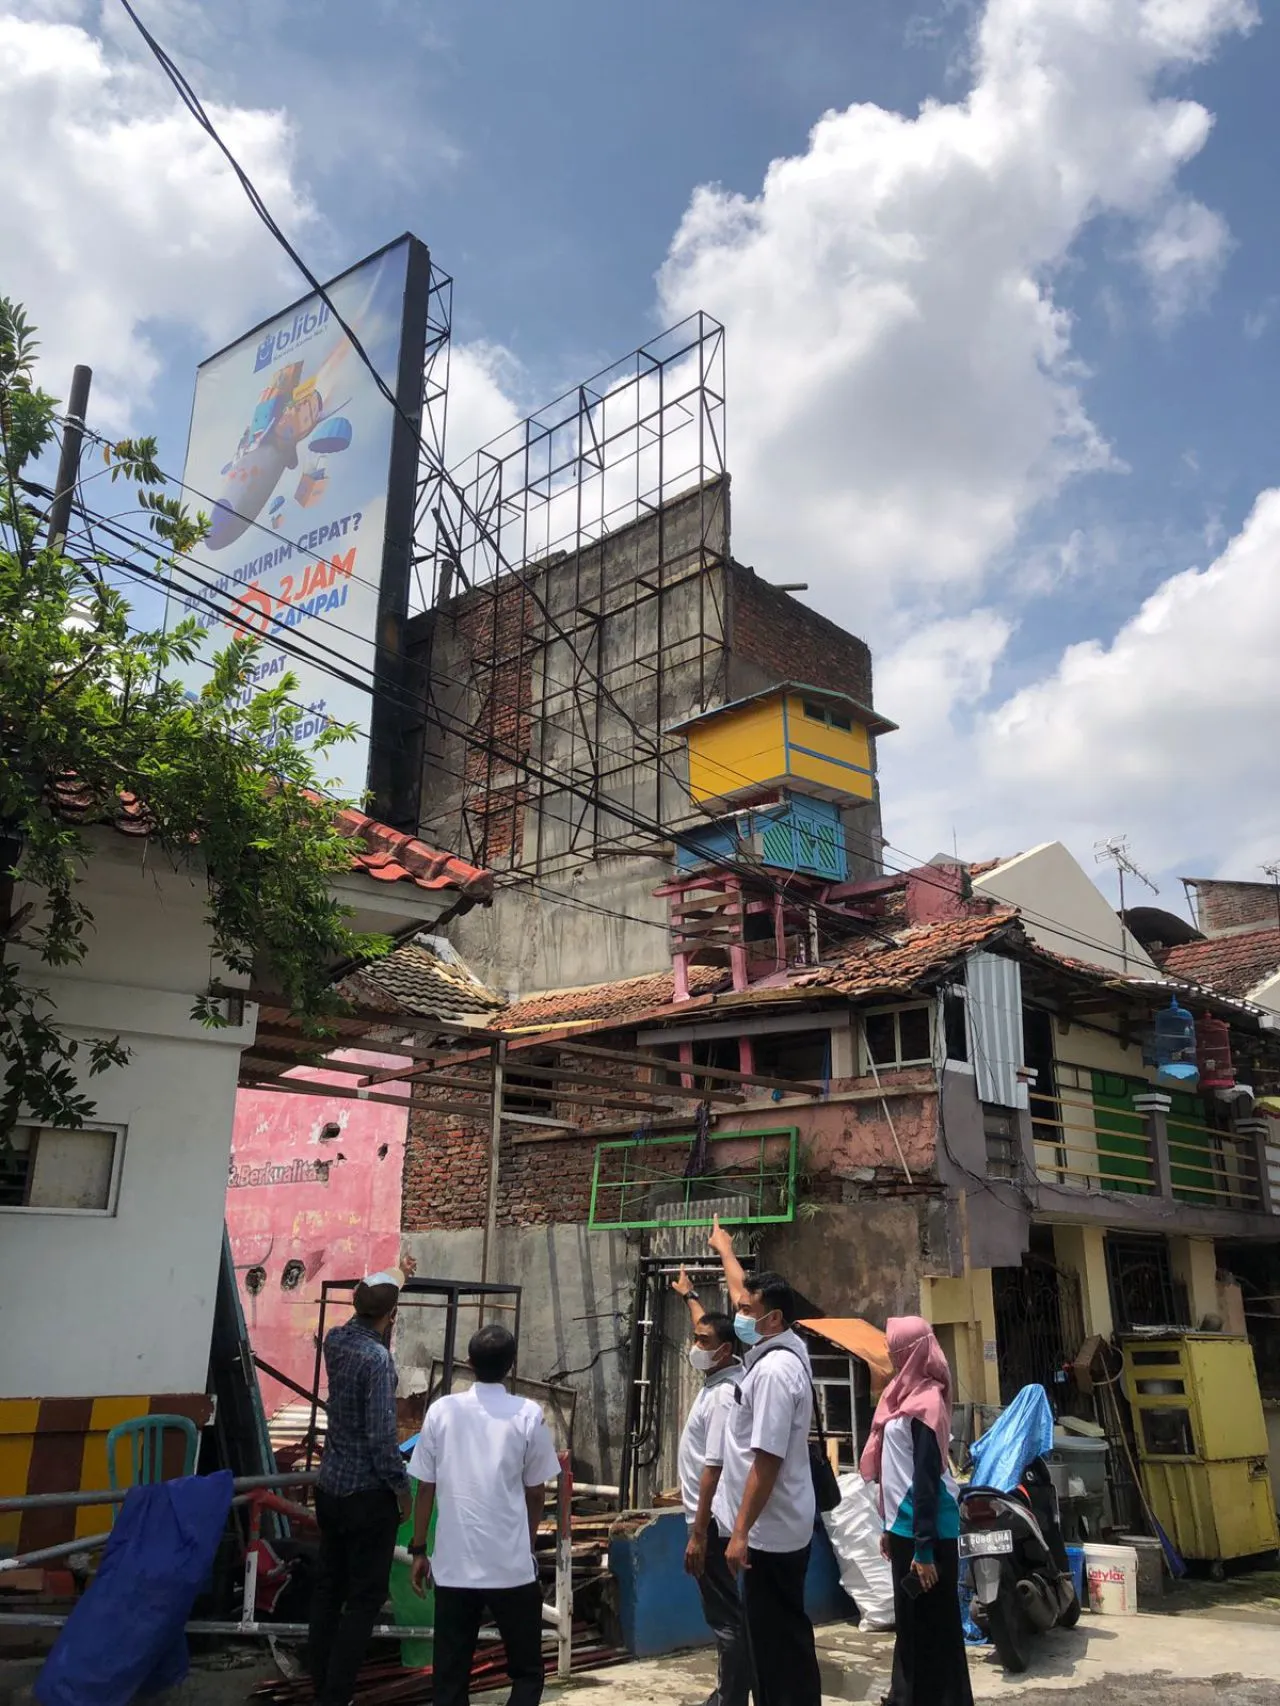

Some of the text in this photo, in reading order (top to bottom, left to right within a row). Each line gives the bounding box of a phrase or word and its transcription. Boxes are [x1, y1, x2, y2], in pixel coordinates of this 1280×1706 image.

[276, 301, 329, 350] blibli
[232, 543, 292, 587] DIKIRIM
[297, 512, 363, 554] CEPAT?
[271, 584, 348, 634] SAMPAI
[240, 1158, 328, 1187] Berkualita
